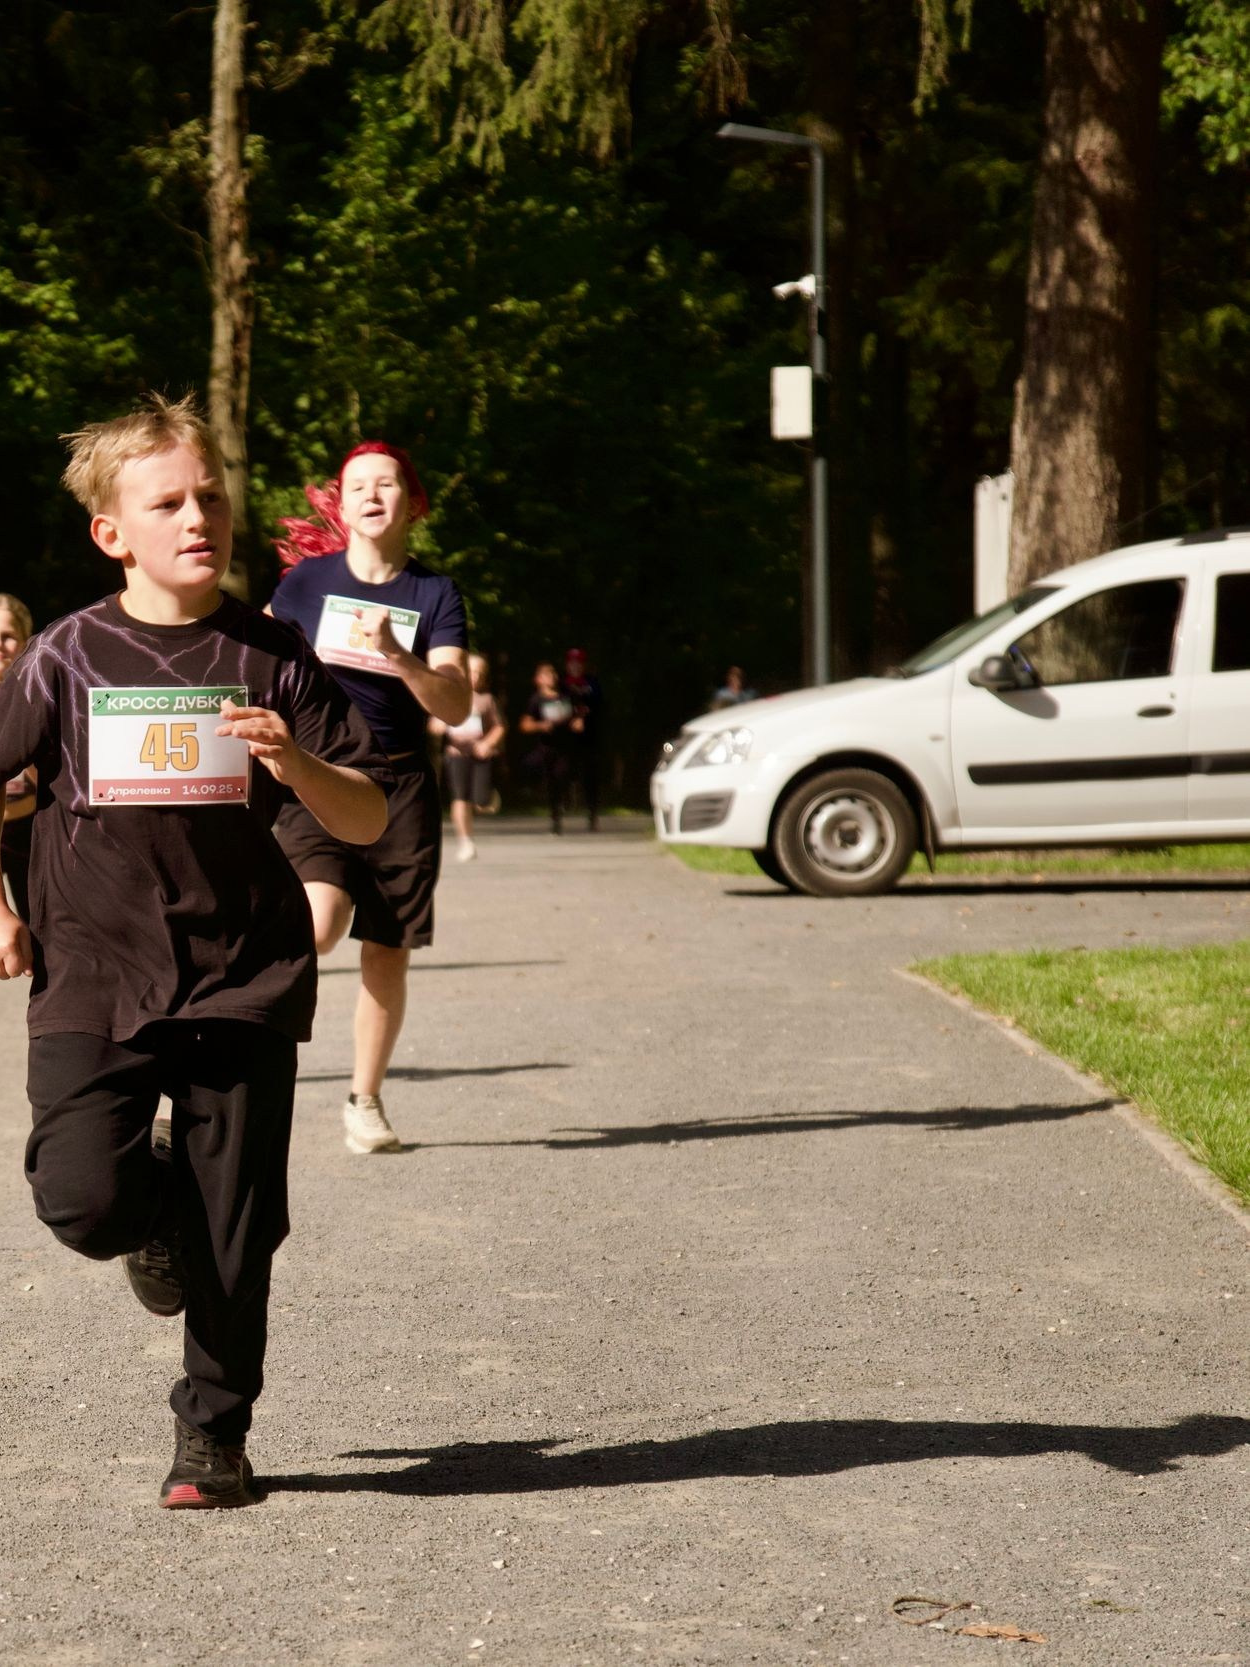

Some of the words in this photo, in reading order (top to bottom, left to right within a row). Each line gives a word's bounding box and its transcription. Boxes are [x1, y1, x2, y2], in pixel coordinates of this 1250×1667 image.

[107, 696, 169, 710] КРОСС
[139, 722, 200, 772] 45
[107, 786, 171, 797] Апрелевка
[182, 784, 233, 795] 14.09.25
